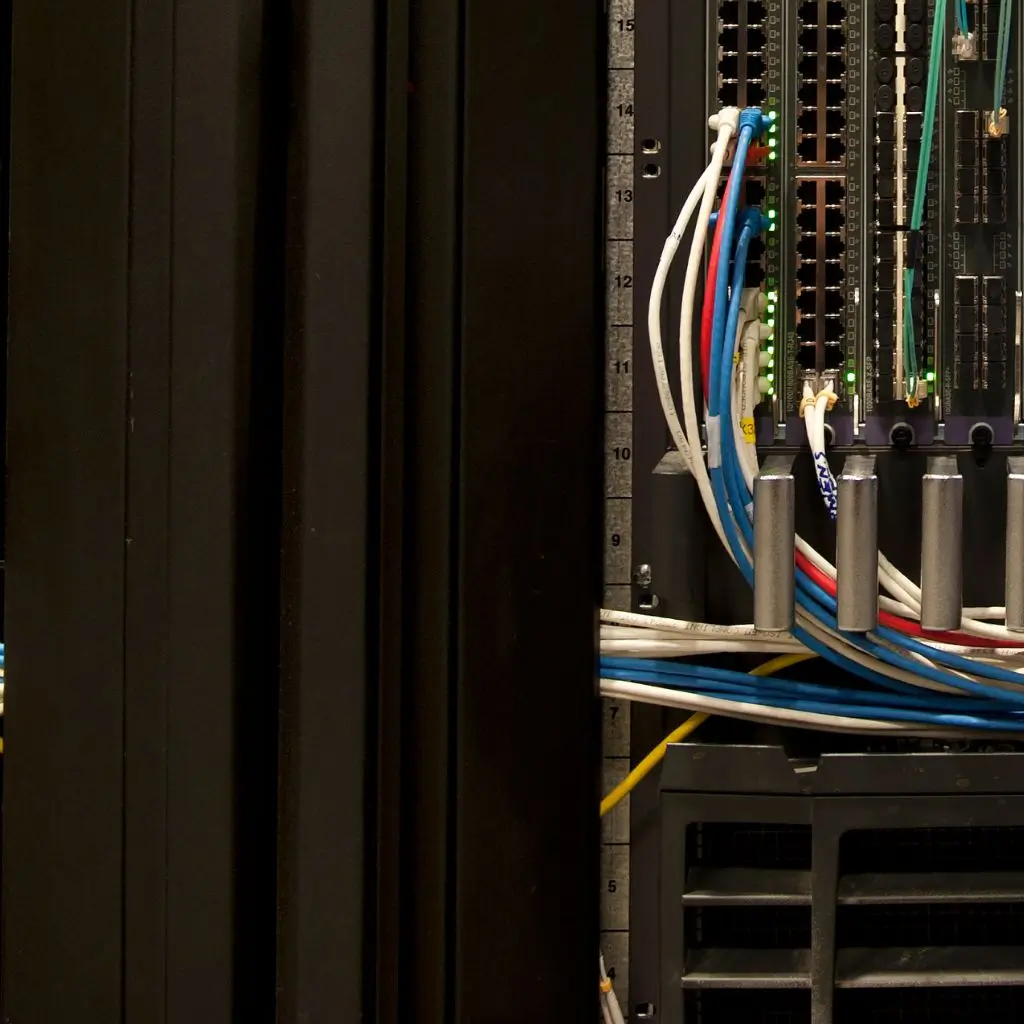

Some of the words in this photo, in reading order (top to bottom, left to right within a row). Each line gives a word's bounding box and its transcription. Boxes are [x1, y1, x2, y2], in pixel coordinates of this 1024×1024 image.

[618, 19, 635, 32] 15
[616, 104, 634, 117] 14
[616, 189, 633, 203] 13
[615, 275, 632, 289] 12
[614, 360, 629, 374] 11
[612, 447, 631, 461] 10
[612, 534, 621, 547] 9
[609, 707, 619, 720] 7
[608, 880, 617, 893] 5
[606, 967, 616, 979] 4
